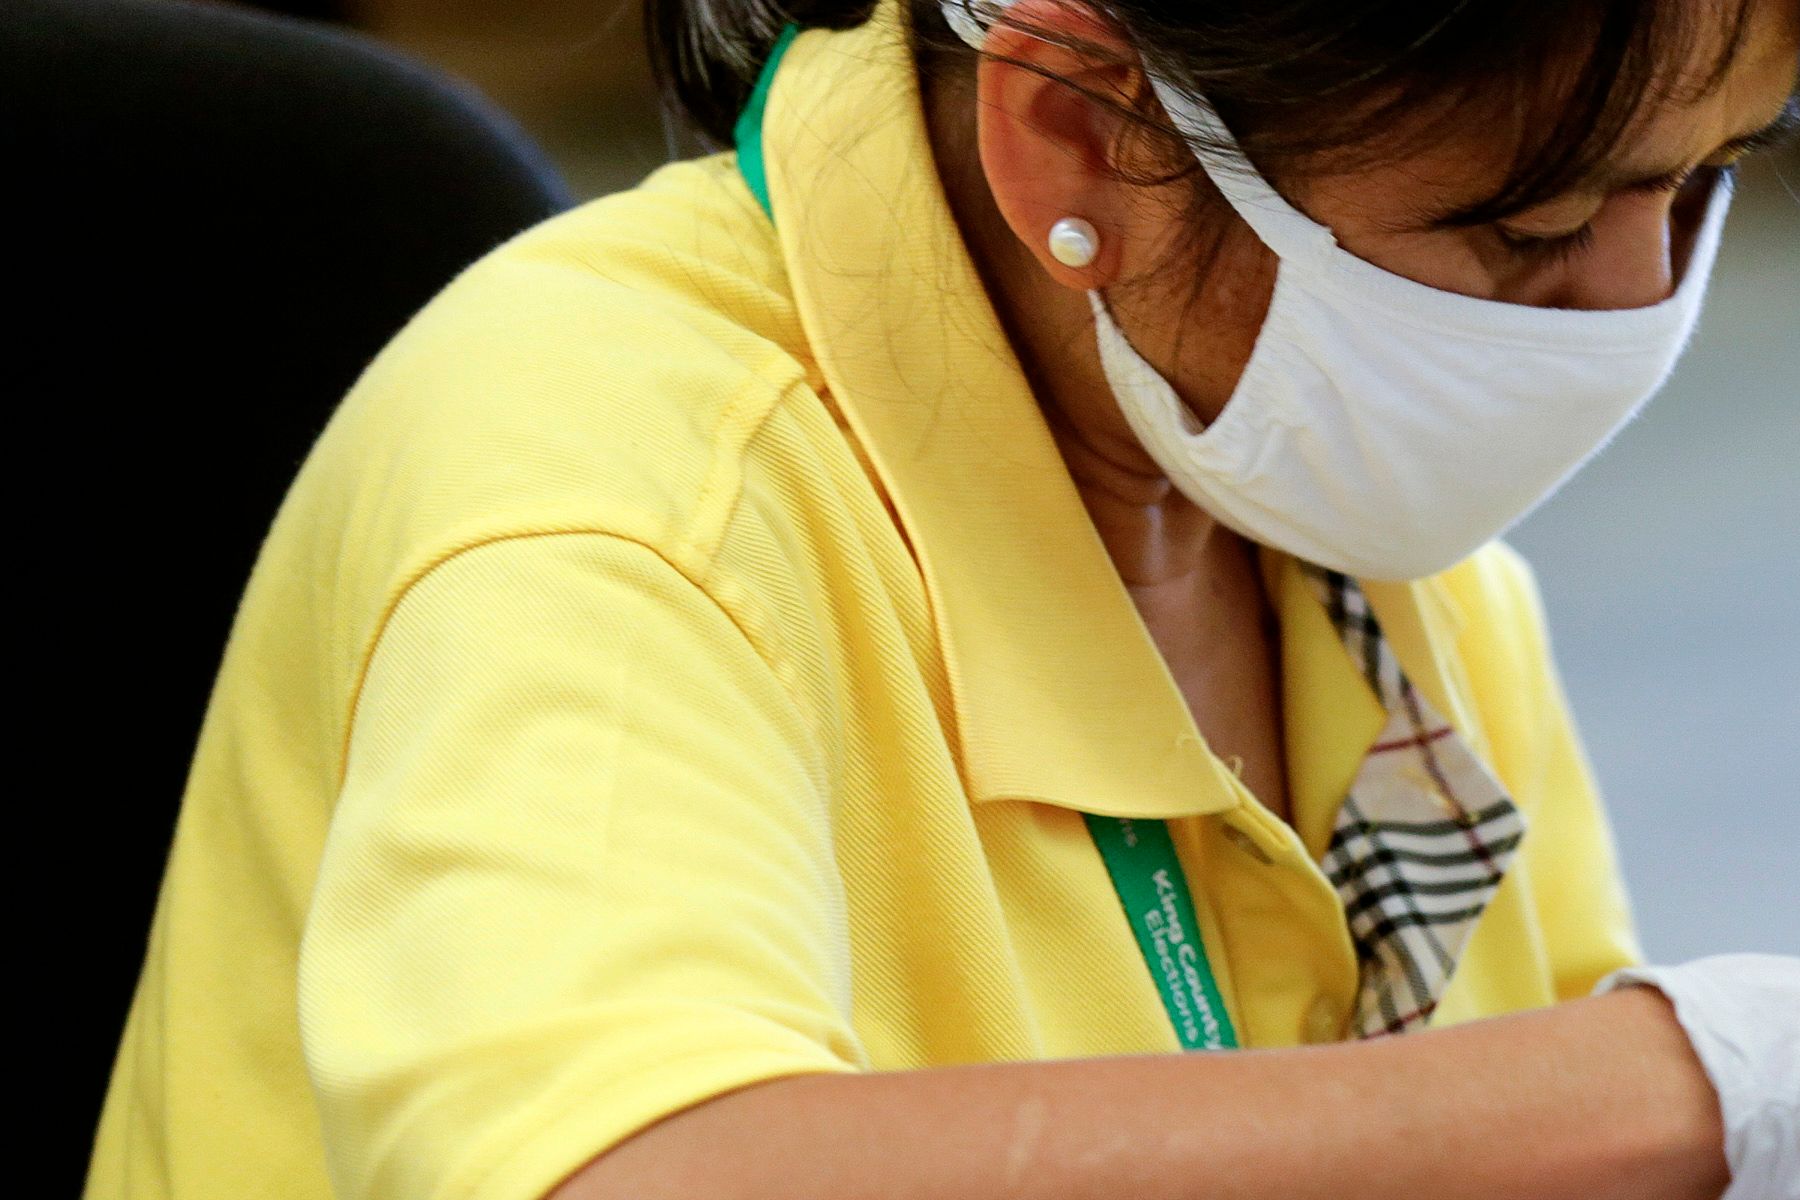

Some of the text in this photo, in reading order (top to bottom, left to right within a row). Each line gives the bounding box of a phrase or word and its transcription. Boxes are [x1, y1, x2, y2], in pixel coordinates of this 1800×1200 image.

[1144, 909, 1198, 1043] Elections
[1152, 868, 1222, 1050] King County
